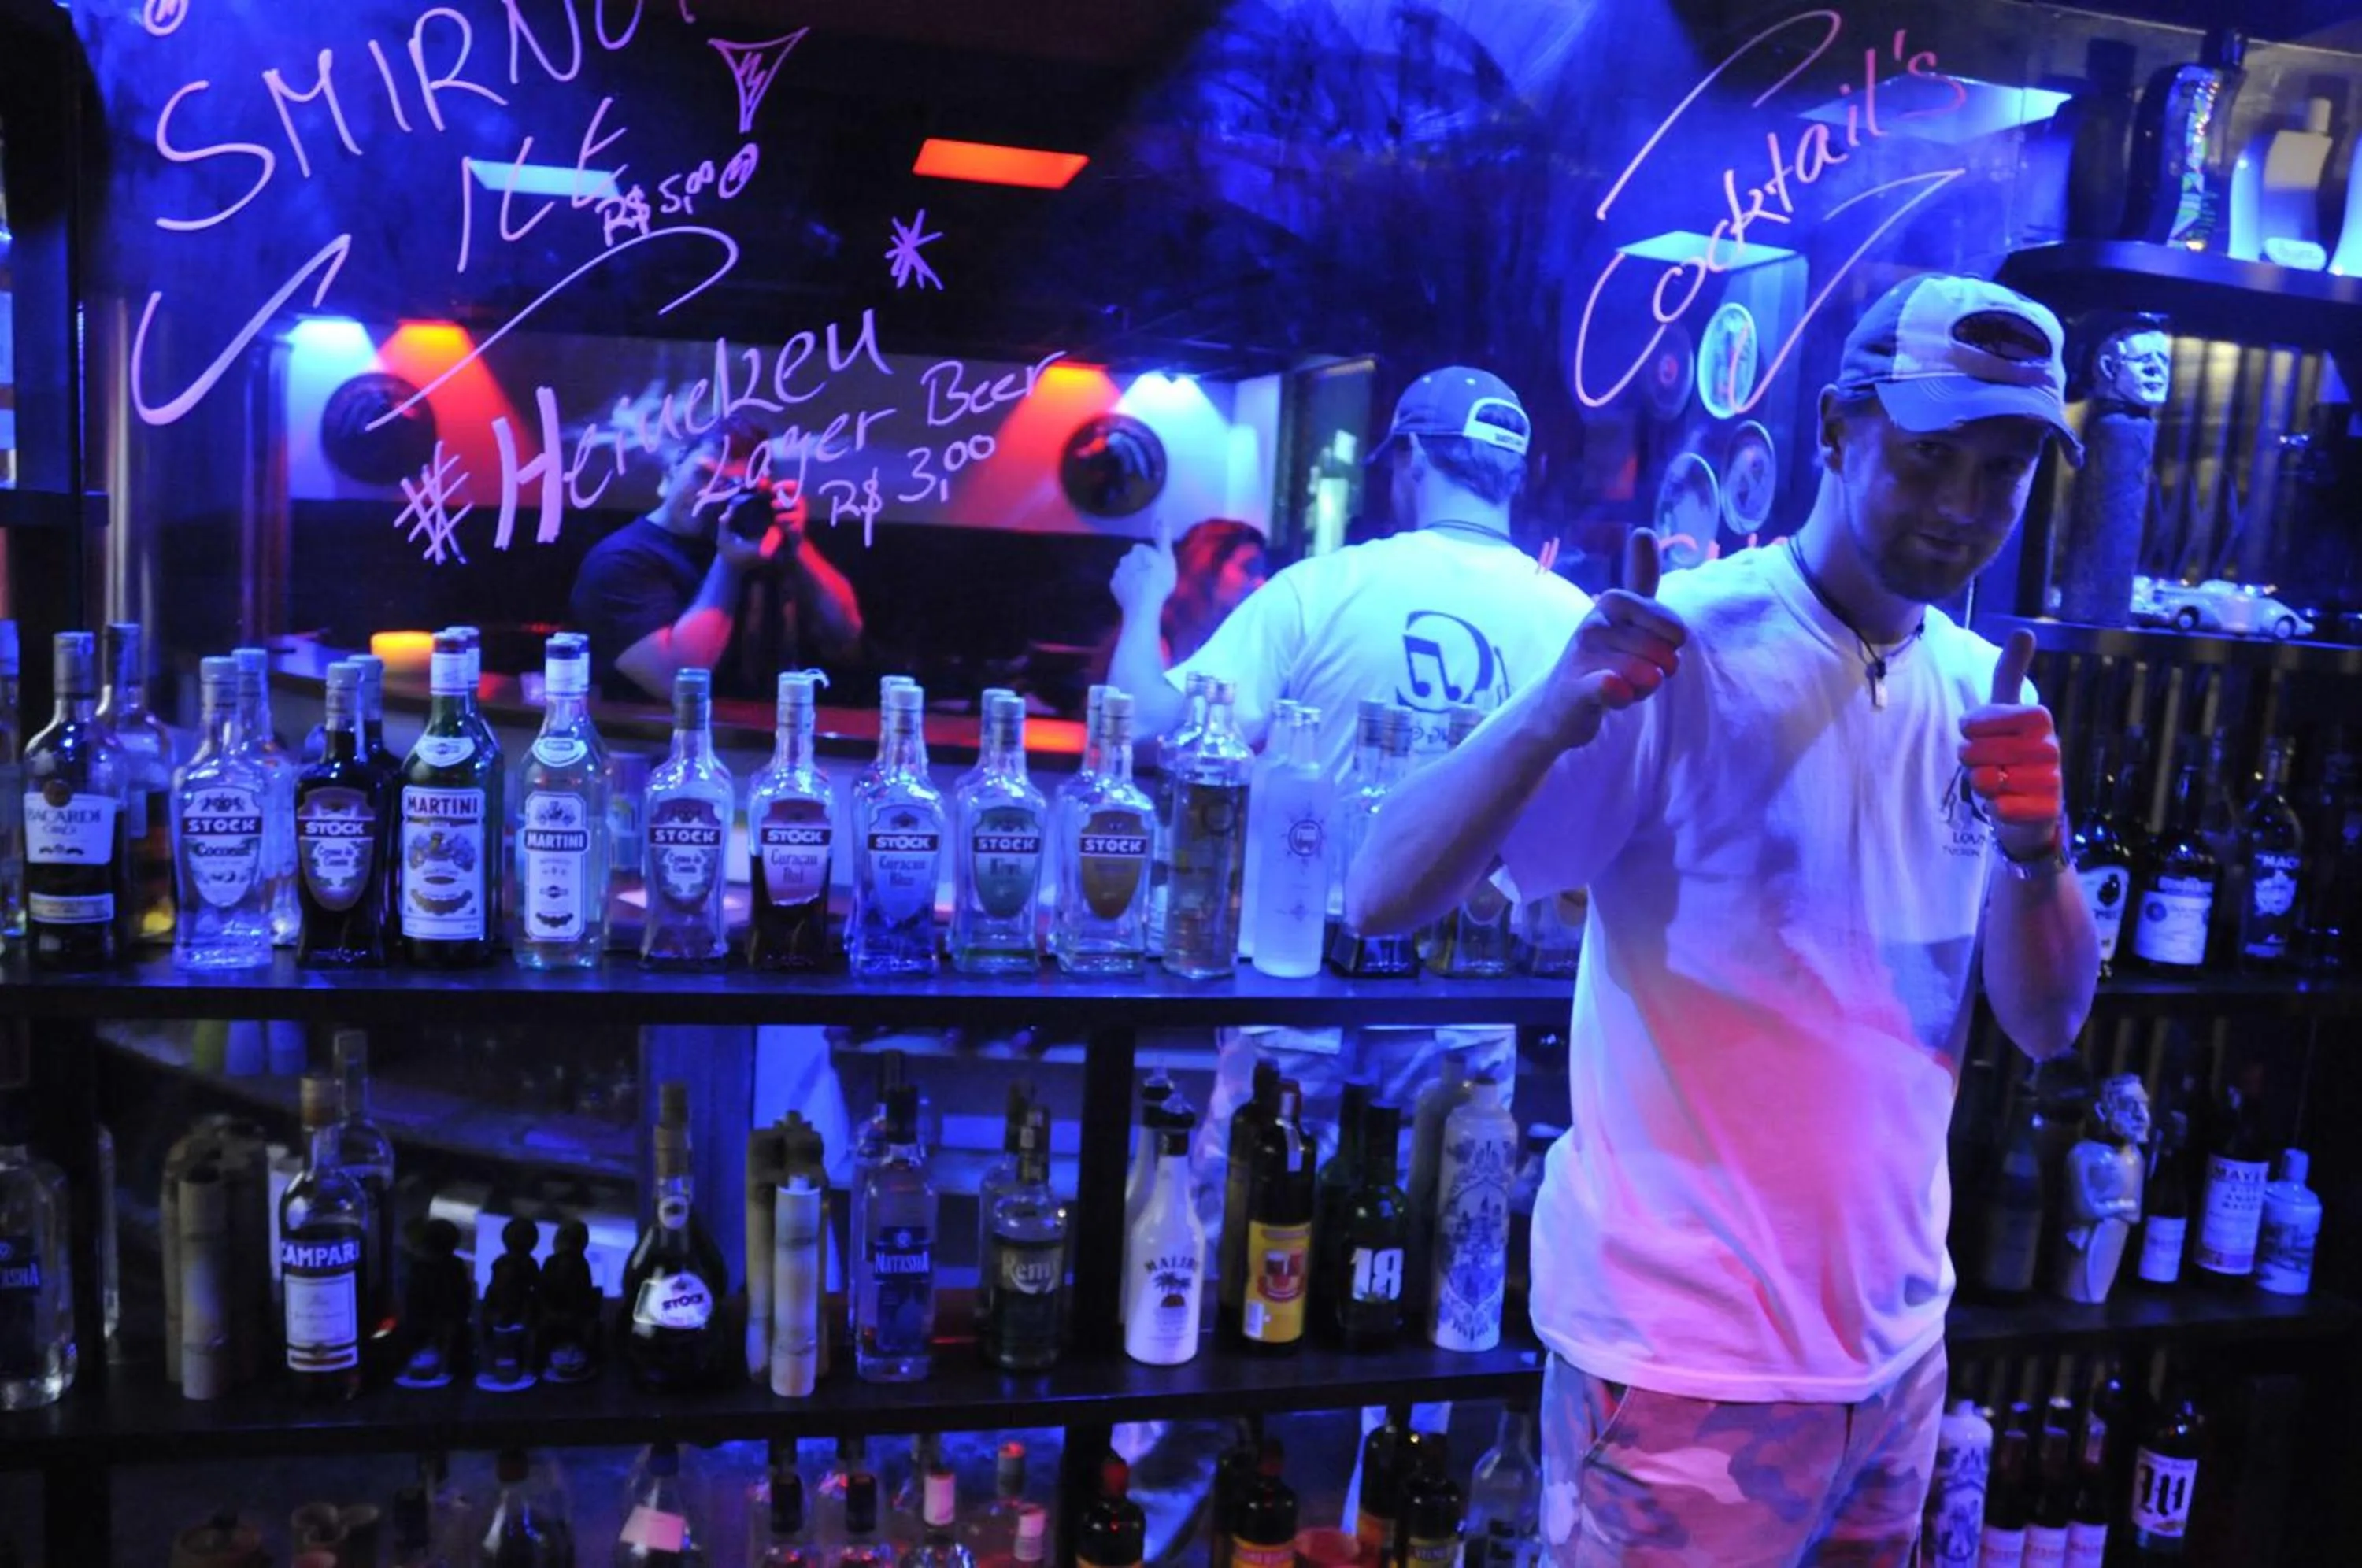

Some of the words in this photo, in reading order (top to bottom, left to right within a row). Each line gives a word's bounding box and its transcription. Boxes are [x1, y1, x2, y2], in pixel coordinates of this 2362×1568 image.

[457, 97, 628, 272] ICE
[1576, 30, 1967, 407] Cocktail's
[691, 407, 896, 517] Lager
[920, 350, 1066, 426] Beer
[819, 466, 883, 548] R$
[406, 796, 479, 815] MARTINI
[27, 806, 103, 823] BACARDI
[187, 818, 256, 833] STOCK
[305, 821, 365, 836] STOCK
[527, 831, 585, 849] MARTINI
[654, 829, 716, 844] STOCK
[767, 829, 824, 844] STOCK
[875, 835, 931, 850] STOCK
[977, 838, 1035, 851] STOCK
[1084, 838, 1143, 852] STOCK
